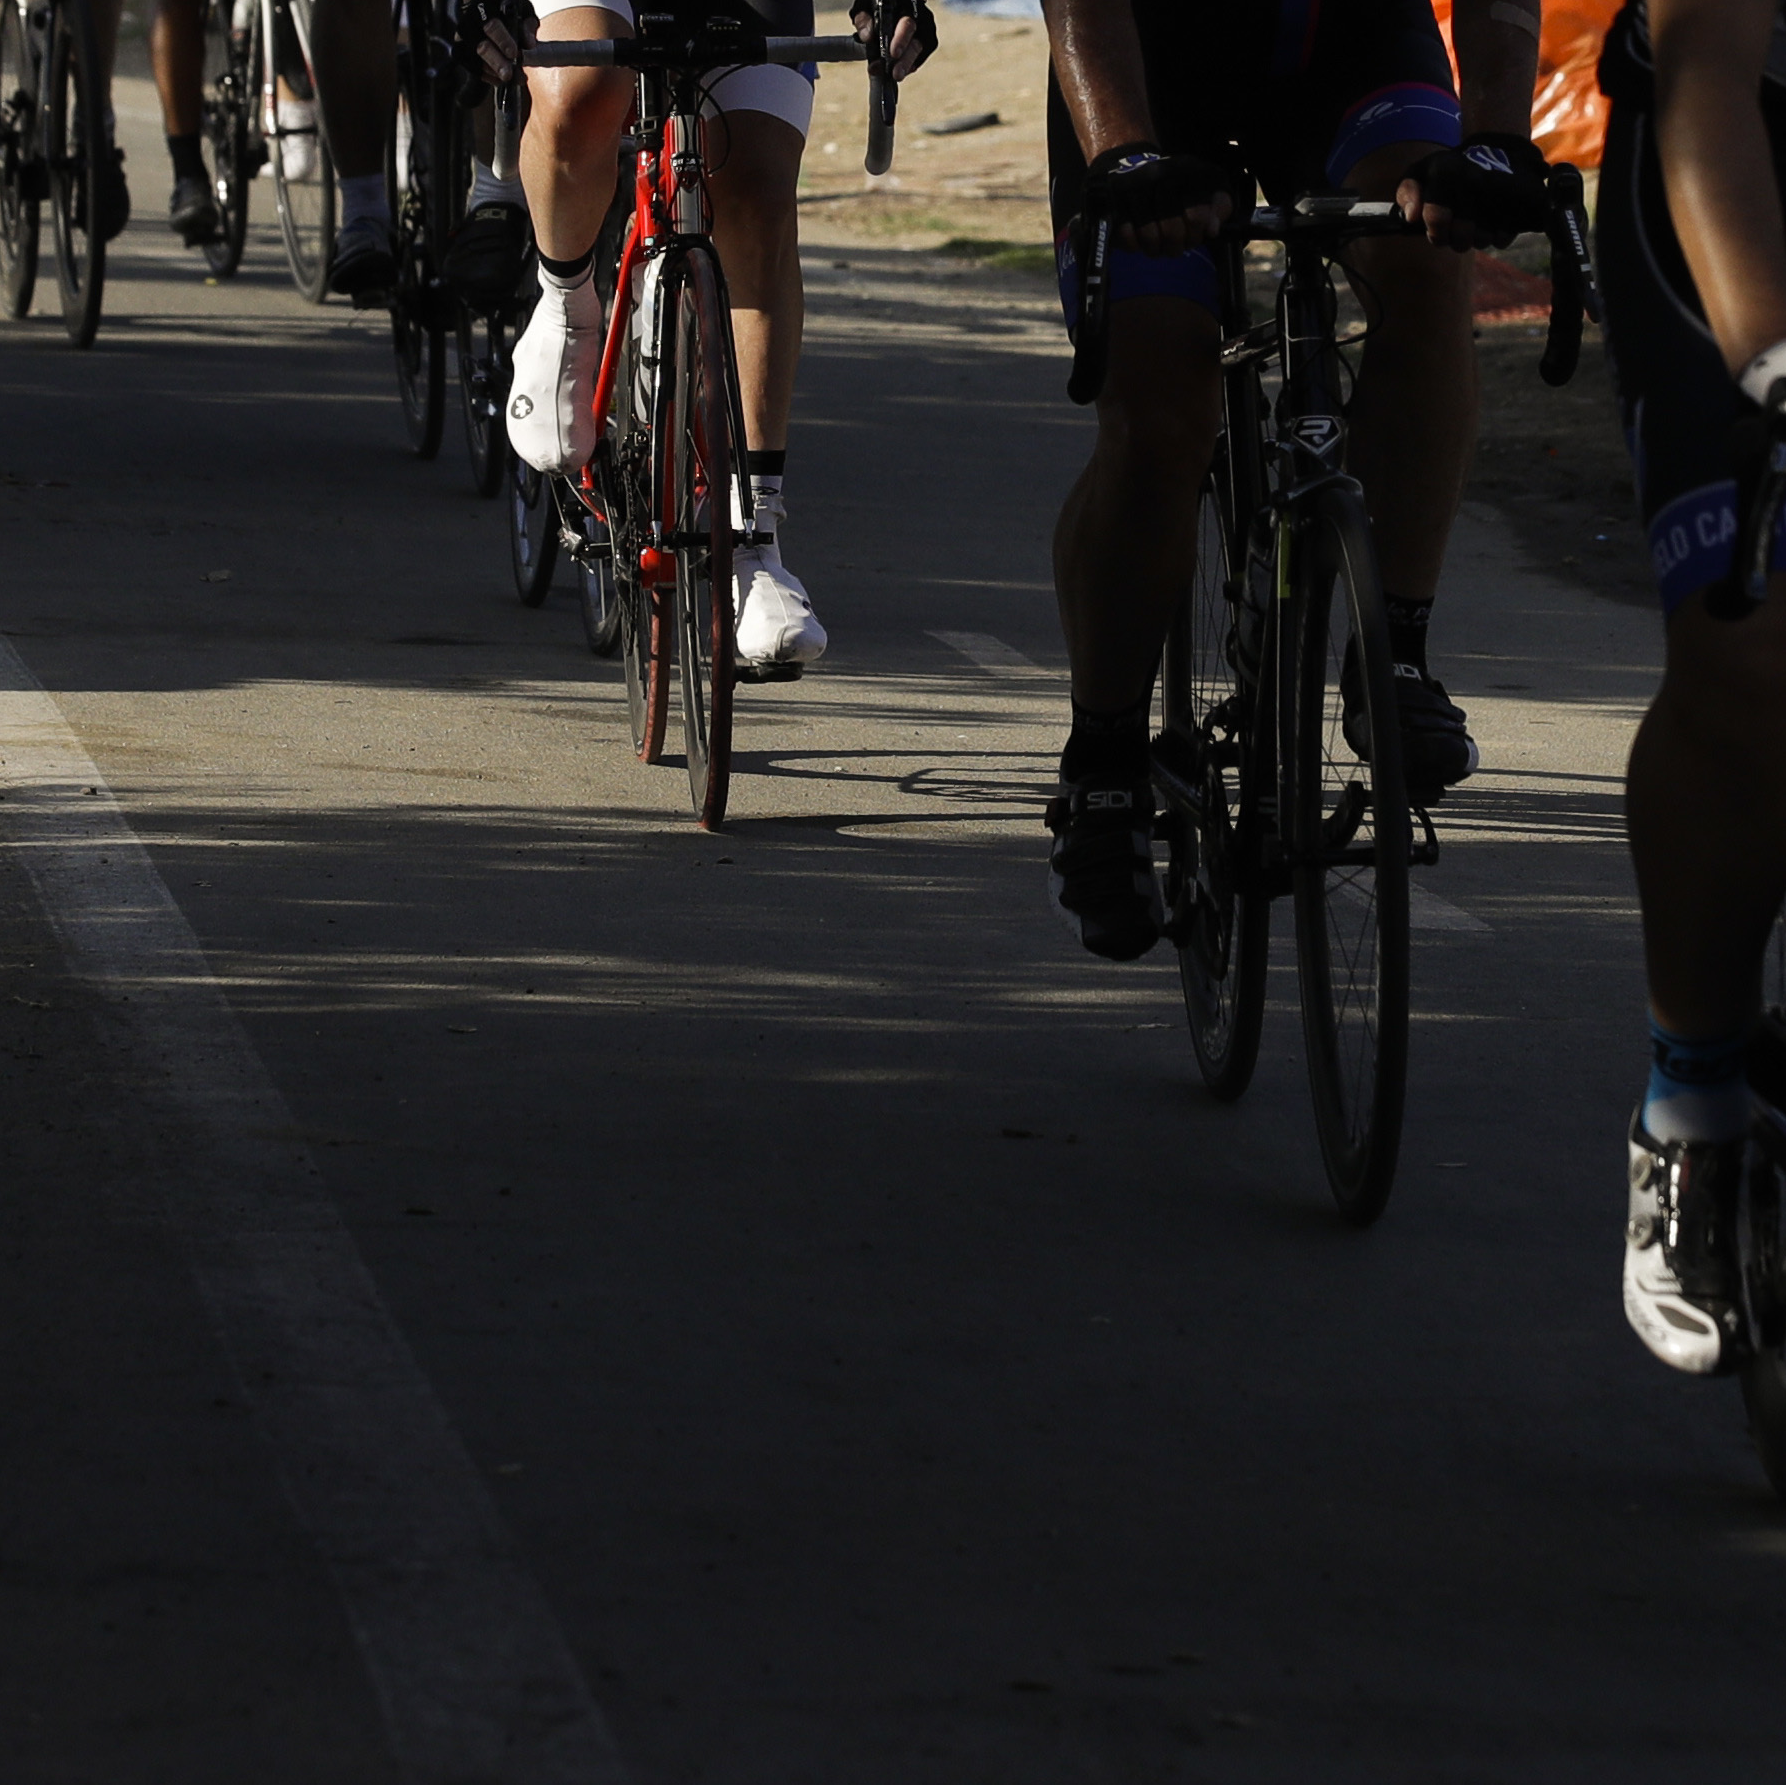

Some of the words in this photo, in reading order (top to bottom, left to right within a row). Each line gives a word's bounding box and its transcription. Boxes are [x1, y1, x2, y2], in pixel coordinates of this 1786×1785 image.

[1094, 219, 1108, 268] SRAM
[1564, 209, 1585, 256] SRAM
[1086, 790, 1133, 811] SIDI
